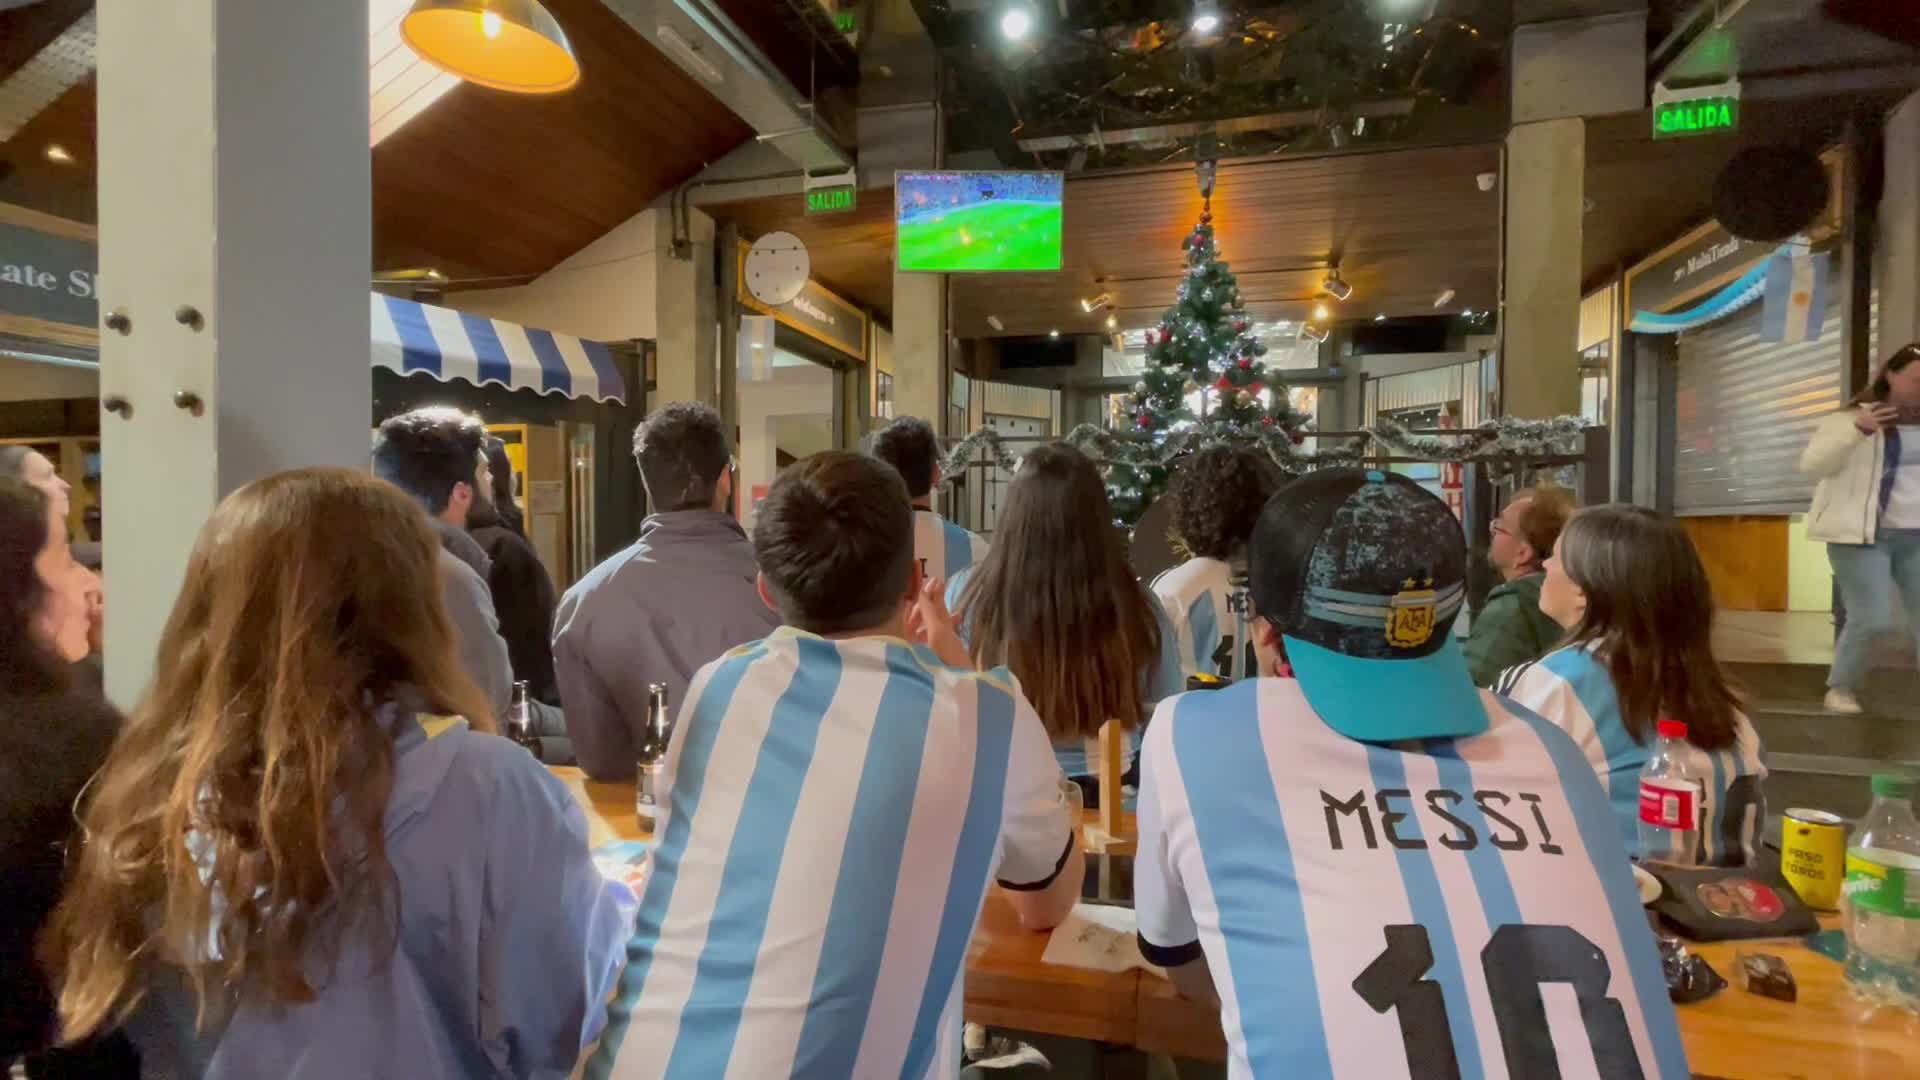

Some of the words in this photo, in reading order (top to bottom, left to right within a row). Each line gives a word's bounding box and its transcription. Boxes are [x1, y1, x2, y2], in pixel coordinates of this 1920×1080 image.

[1658, 103, 1732, 133] SALIDA
[808, 191, 851, 211] SALIDA
[1319, 788, 1564, 856] MESSI
[1352, 924, 1646, 1080] 10
